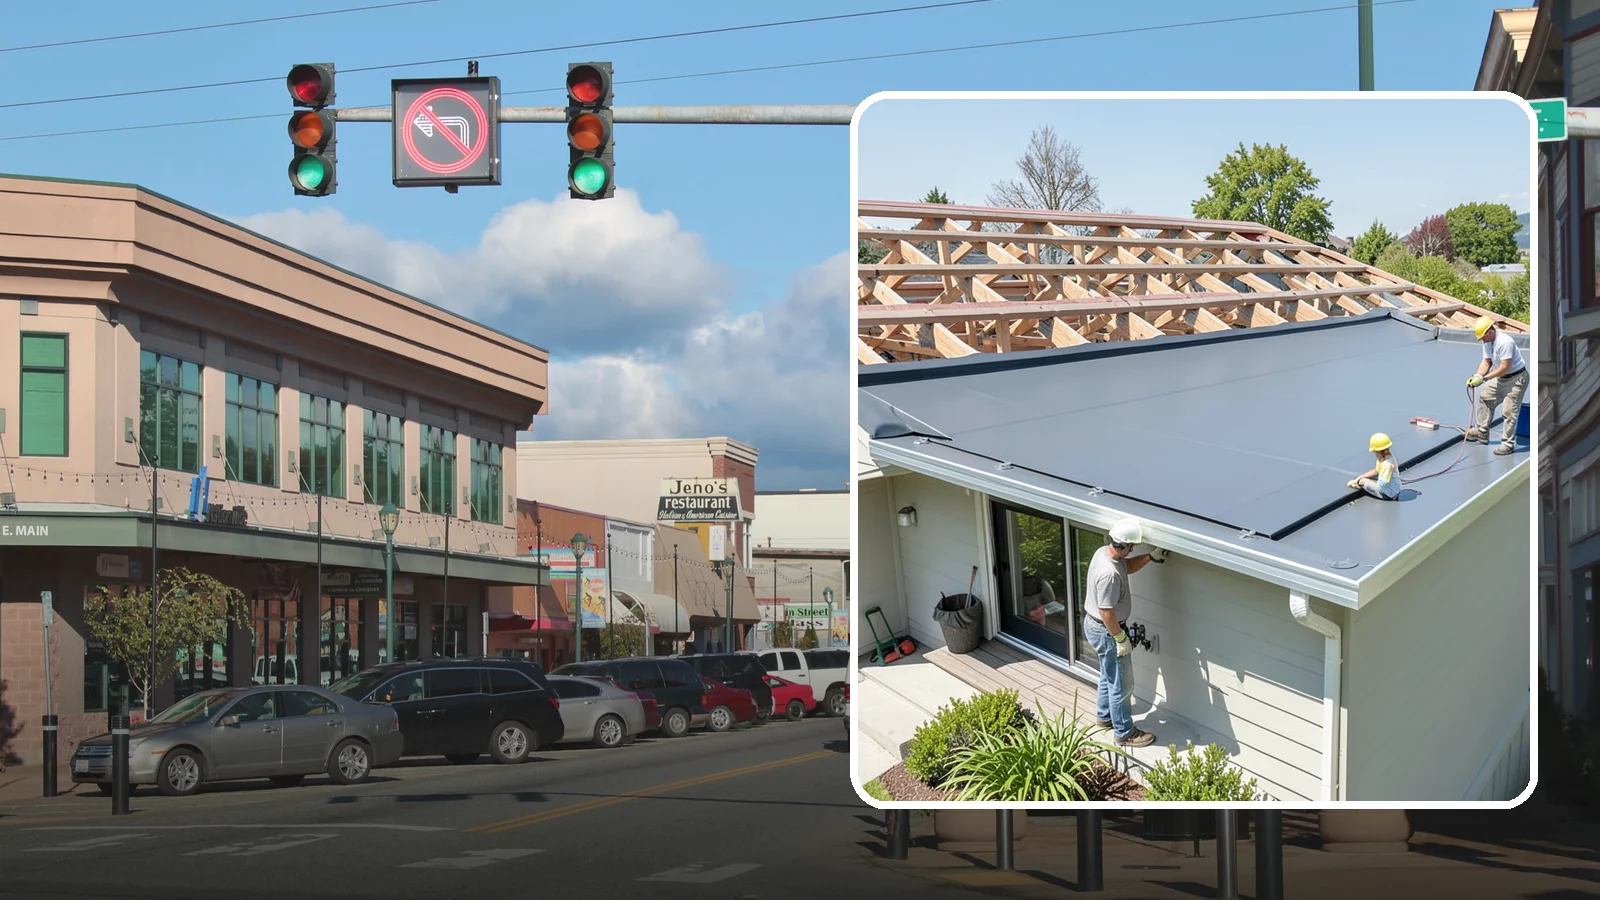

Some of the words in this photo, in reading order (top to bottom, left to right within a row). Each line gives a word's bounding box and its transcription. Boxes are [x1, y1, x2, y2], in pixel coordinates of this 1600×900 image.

[670, 480, 727, 494] Jeno's
[665, 496, 731, 509] restaurant
[686, 510, 714, 519] American
[715, 510, 737, 519] Cuisine
[2, 525, 13, 536] E.
[15, 525, 49, 536] MAIN
[786, 608, 795, 616] in
[798, 608, 828, 616] Street
